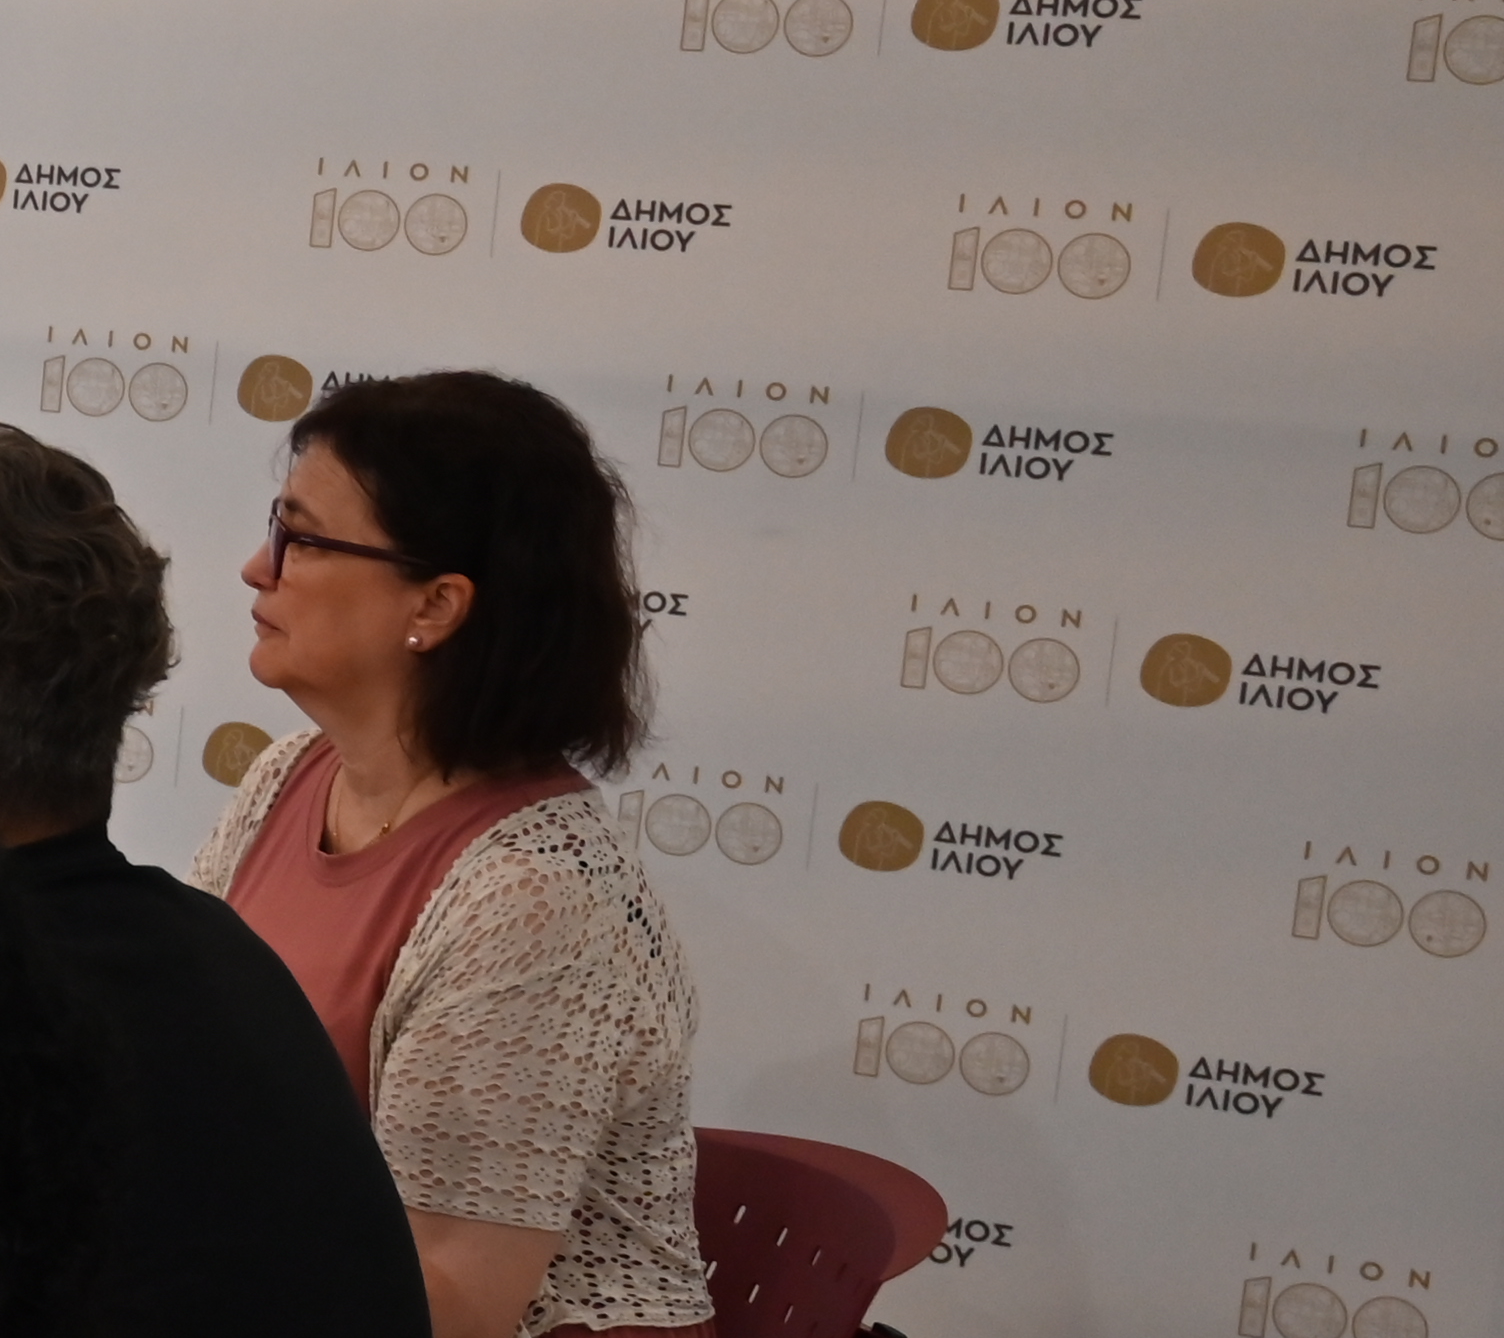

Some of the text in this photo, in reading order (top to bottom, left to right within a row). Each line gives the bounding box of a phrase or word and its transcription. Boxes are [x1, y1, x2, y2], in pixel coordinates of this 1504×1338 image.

[1006, 21, 1102, 48] ΙΛΙΟΥ
[15, 163, 121, 189] ΔΗΜΟΣ
[317, 157, 470, 184] ΙΛΙΟΝ
[13, 189, 89, 213] ΙΛΙΟΥ
[610, 199, 732, 227] ΔΗΜΟΣ
[959, 193, 1133, 223] ΙΛΙΟΝ
[608, 226, 695, 252] ΙΛΙΟΥ
[1296, 239, 1437, 270] ΔΗΜΟΣ
[1293, 268, 1395, 297] ΙΛΙΟΥ
[47, 326, 189, 354] ΙΛΙΟΝ
[666, 374, 830, 405] ΙΛΙΟΝ
[982, 424, 1114, 457] ΔΗΜΟΣ
[1359, 428, 1500, 458] ΙΛΙΟ
[979, 452, 1074, 481] ΙΛΙΟΥ
[911, 593, 1083, 629] ΙΛΙΟΝ
[1239, 653, 1381, 690] ΔΗΜΟΣ
[1239, 681, 1339, 714] ΙΛΙΟΥ
[651, 761, 785, 796] ΛΙΟΝ
[931, 821, 1063, 858] ΔΗΜΟΣ
[931, 848, 1024, 880] ΙΛΙΟΥ
[1297, 841, 1490, 882] ΙΛΙΟΝ
[857, 983, 1032, 1023] ΙΛΙΟΝ
[1185, 1057, 1325, 1098] ΔΗΜΟΣ
[1185, 1083, 1284, 1119] ΙΛΙΟΥ
[1249, 1242, 1431, 1290] ΙΛΙΟΝ
